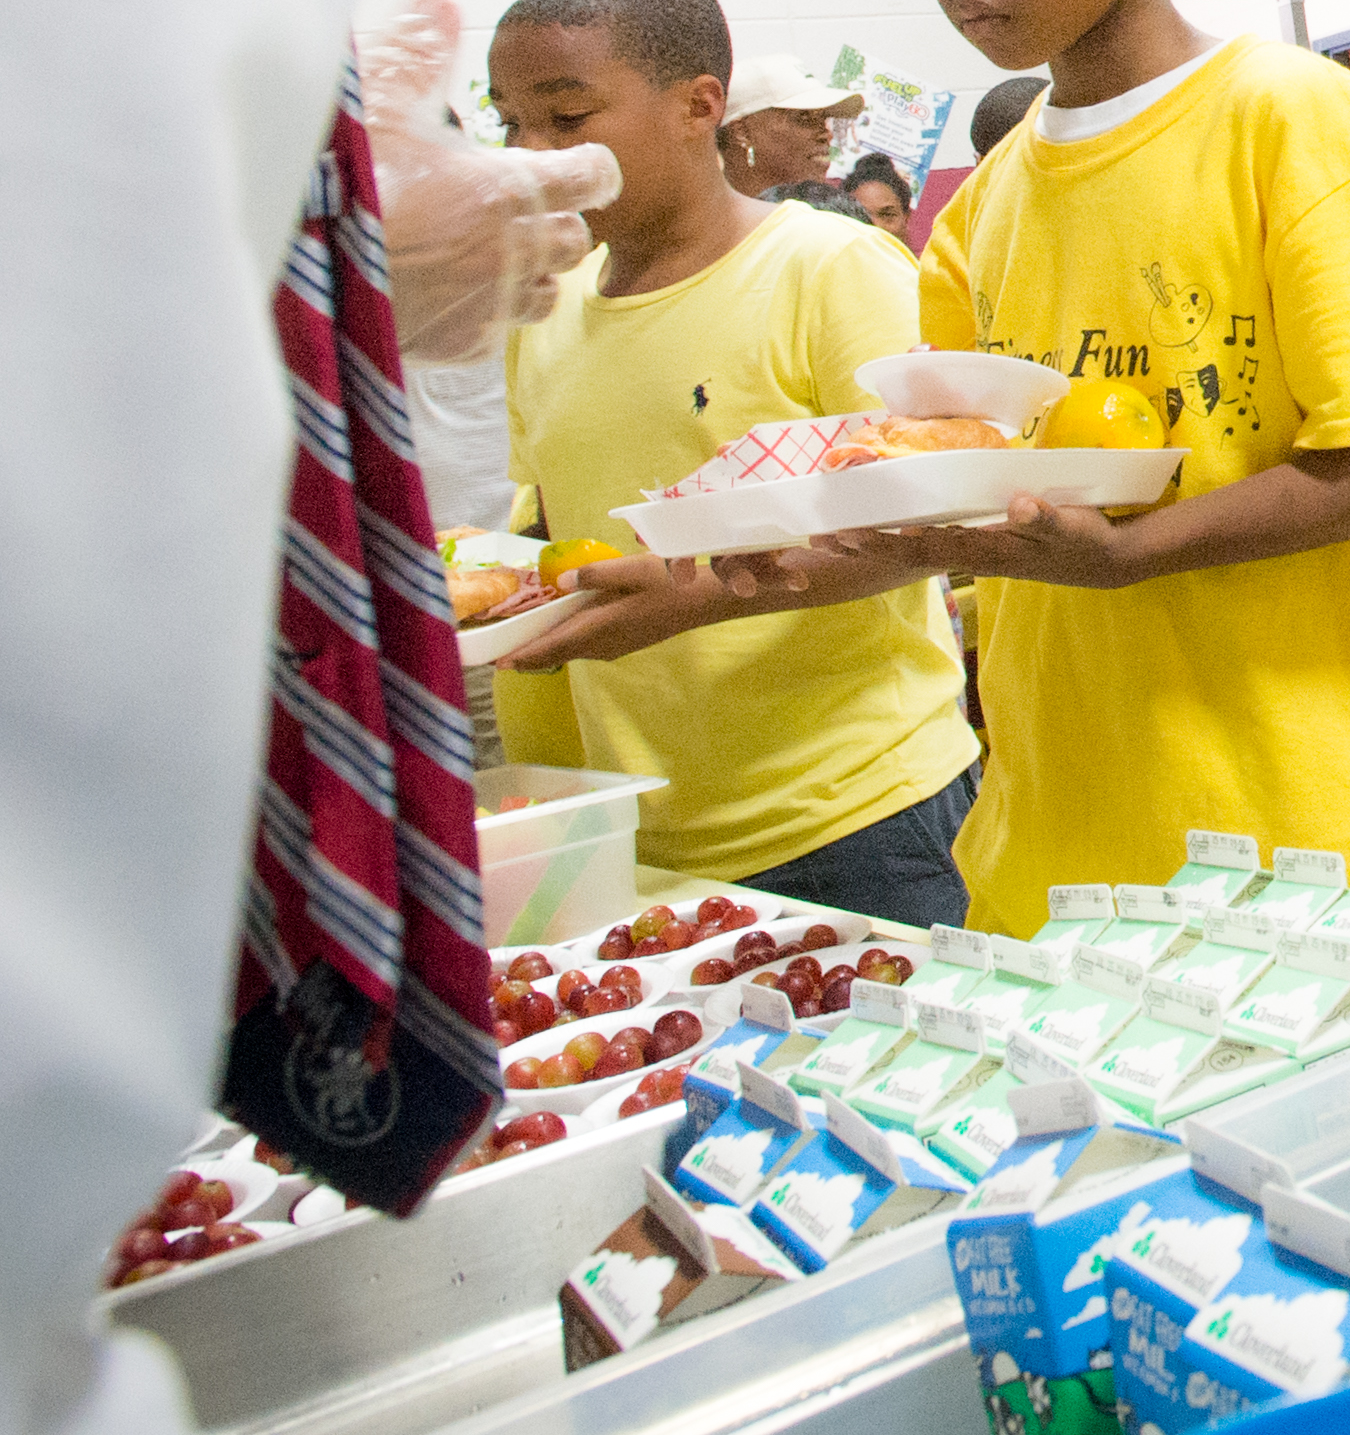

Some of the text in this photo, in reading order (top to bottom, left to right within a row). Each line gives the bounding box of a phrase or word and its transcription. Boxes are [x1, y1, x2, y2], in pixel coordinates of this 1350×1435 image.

[1069, 329, 1150, 378] Fun
[1039, 1017, 1088, 1052] Cloverland
[1253, 1008, 1302, 1031] Cloverland
[1112, 1059, 1164, 1088] Cloverland
[1230, 1320, 1316, 1382] Cloverland
